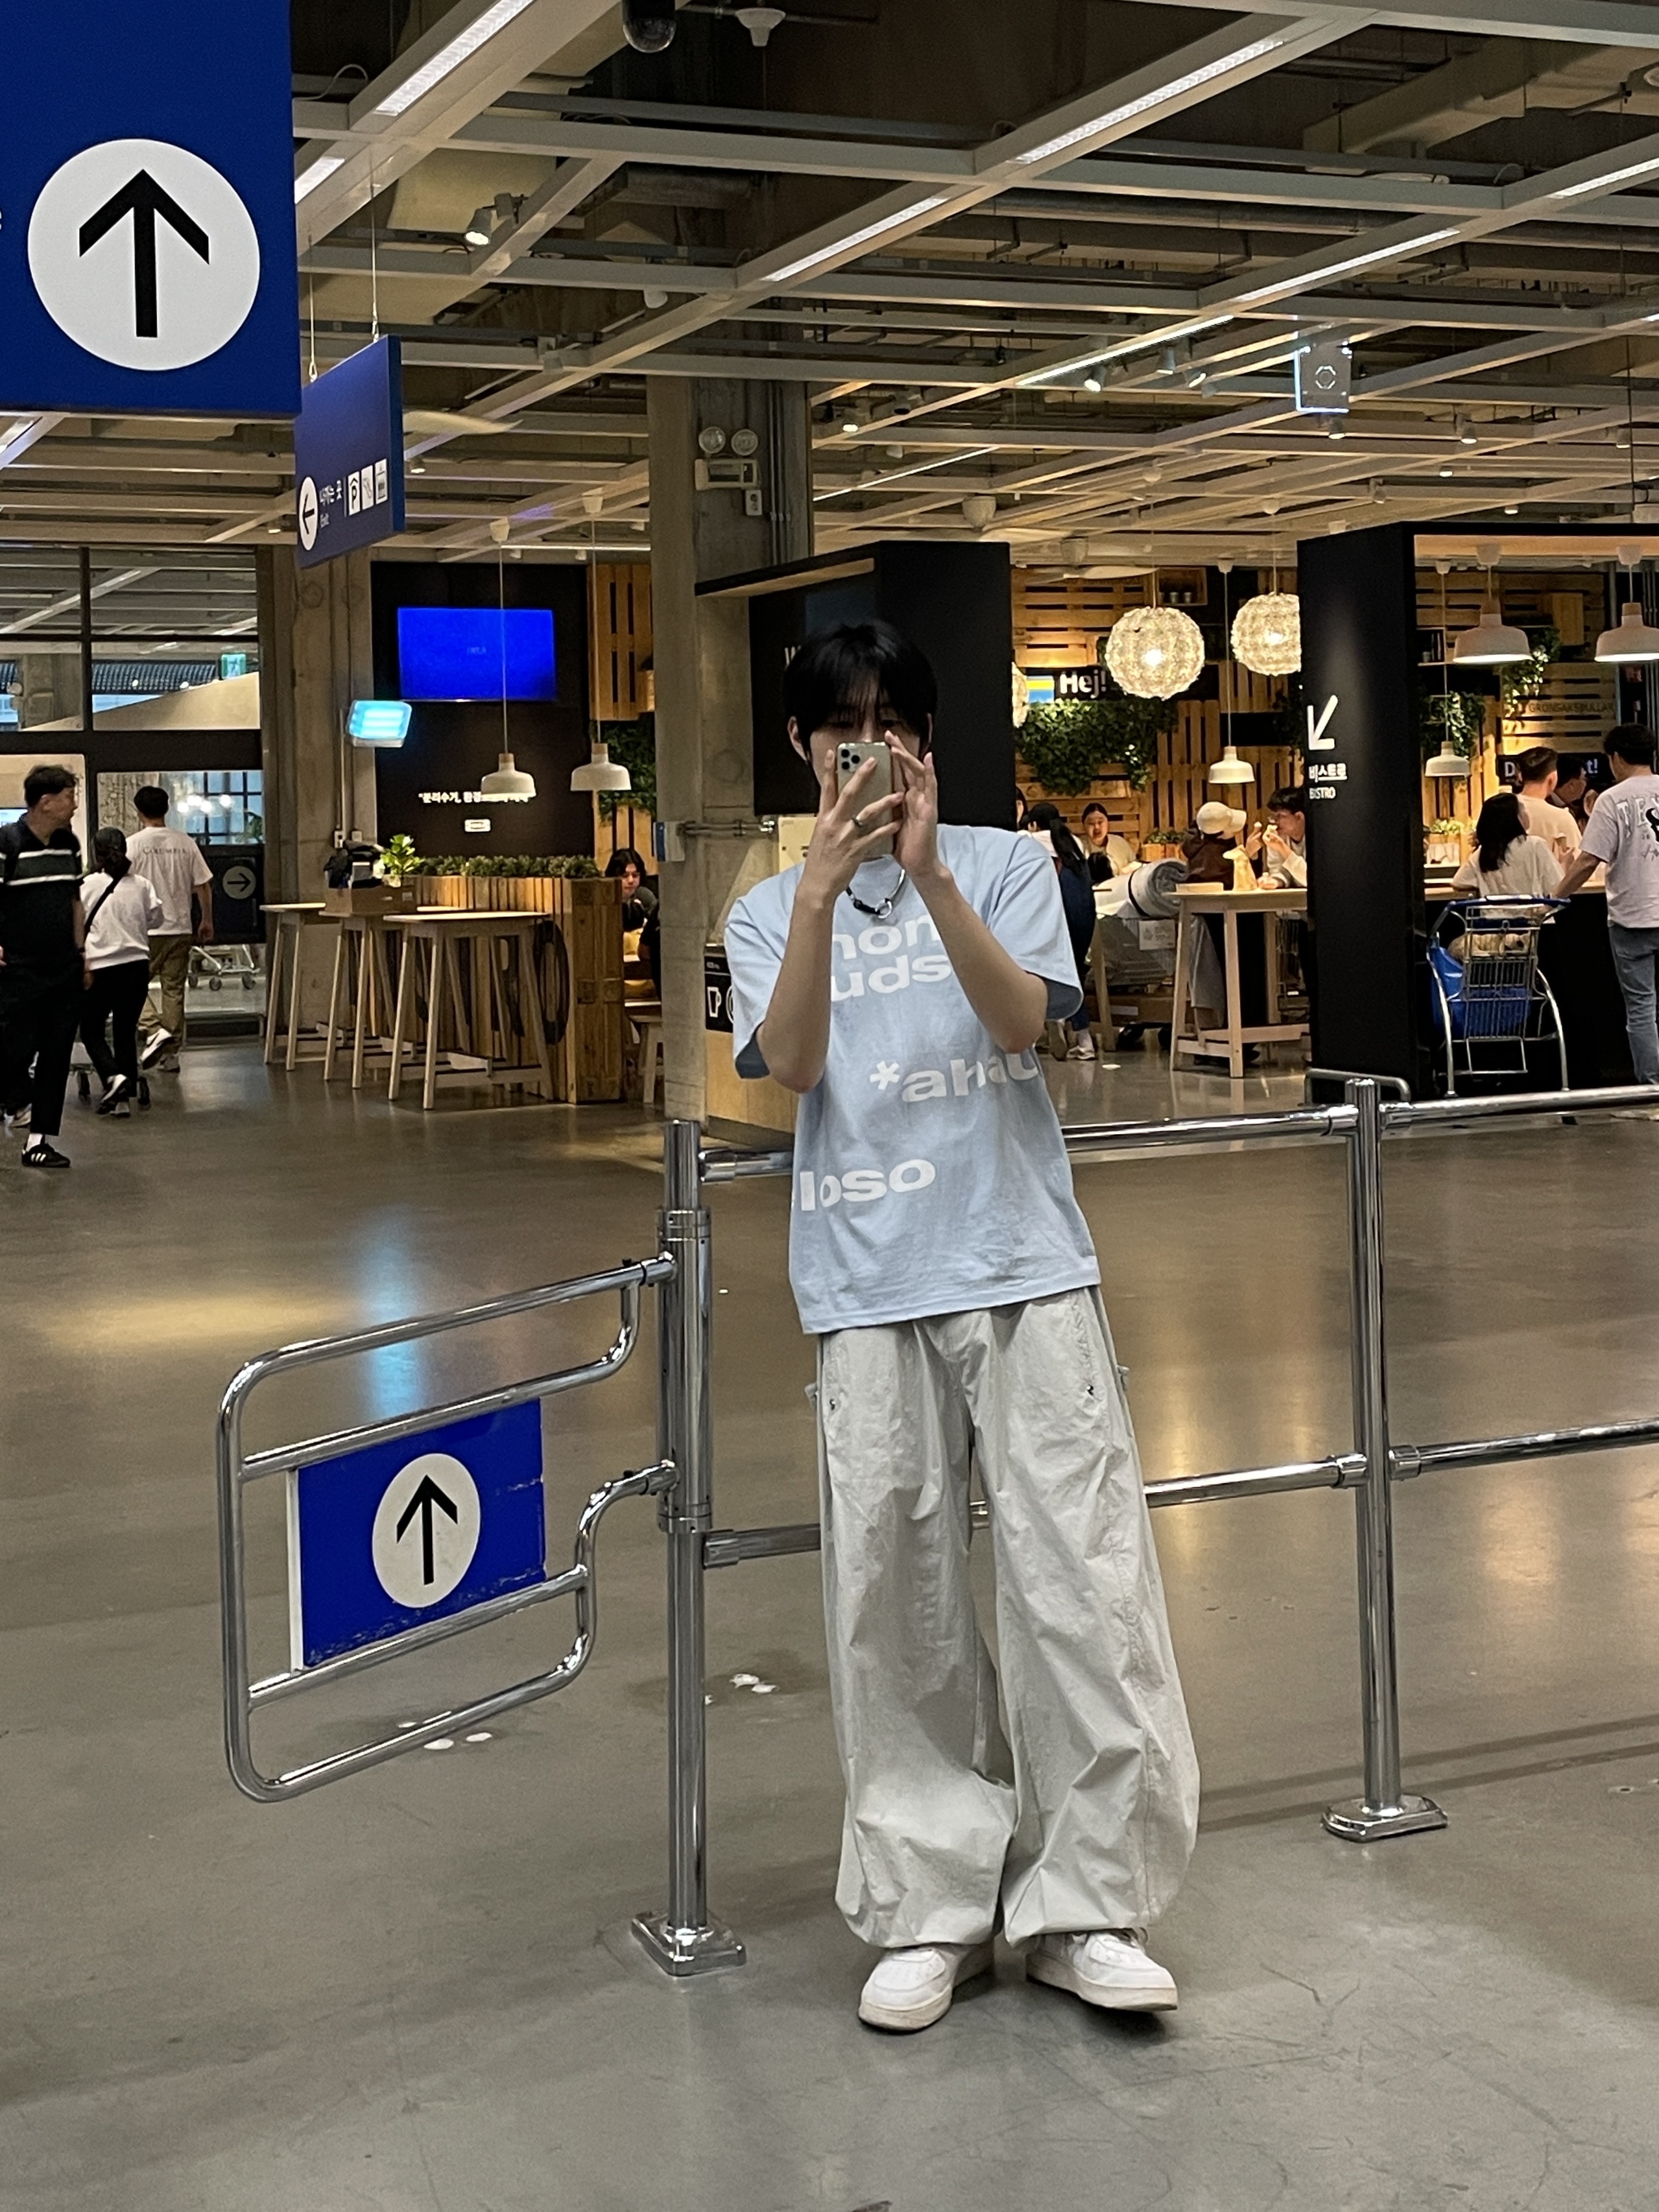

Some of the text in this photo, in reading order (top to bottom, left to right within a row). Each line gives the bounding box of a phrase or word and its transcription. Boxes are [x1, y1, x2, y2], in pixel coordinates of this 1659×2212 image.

[1059, 670, 1106, 699] Hej!
[1309, 763, 1348, 783] 비스트로
[1309, 787, 1336, 799] BISTRO
